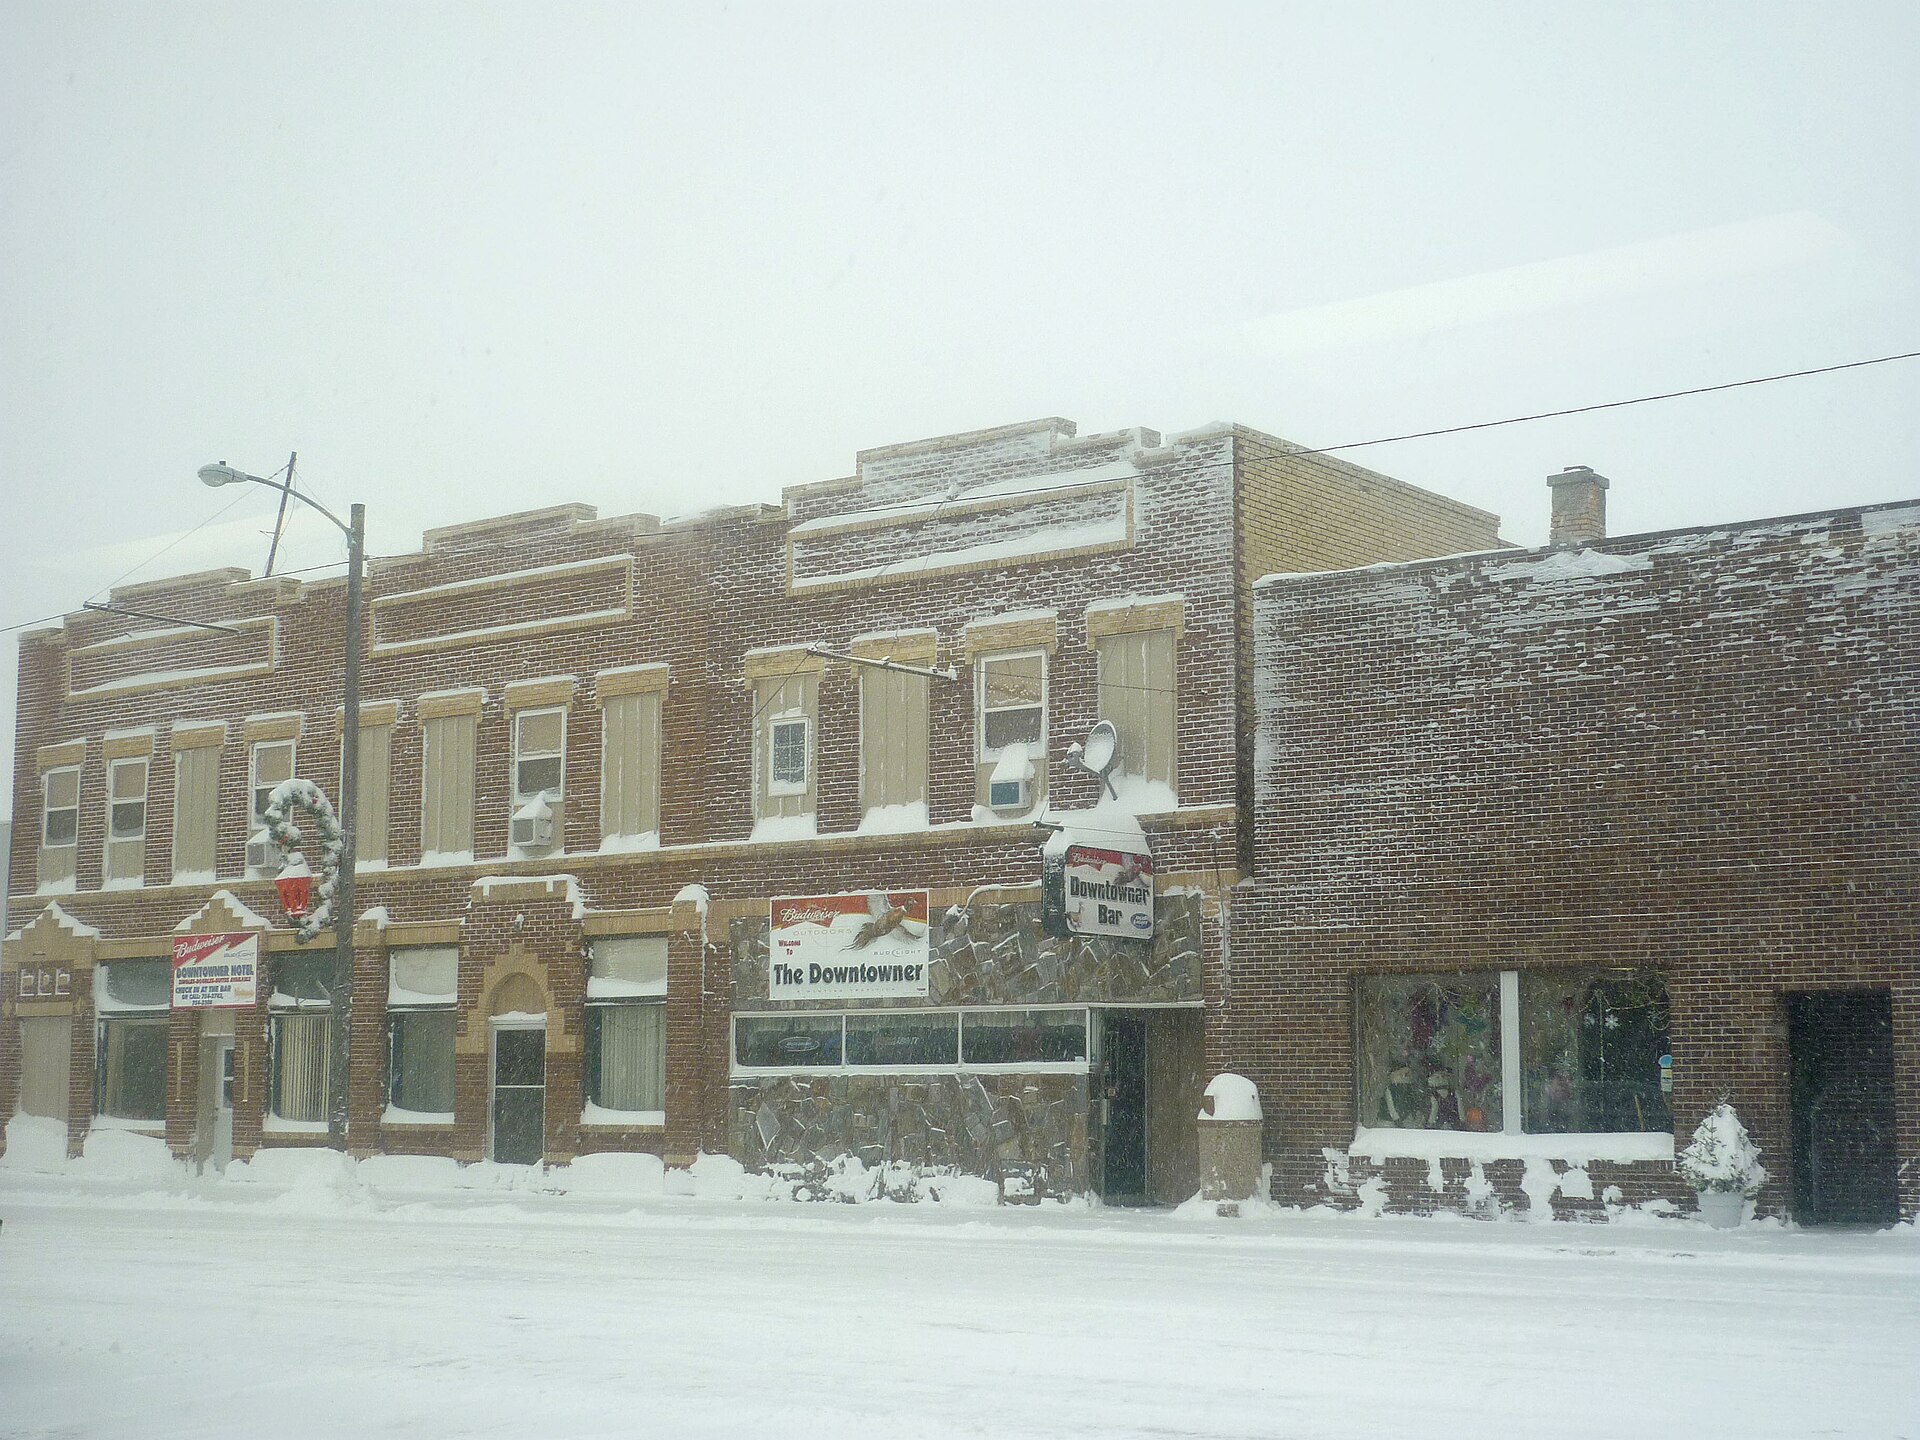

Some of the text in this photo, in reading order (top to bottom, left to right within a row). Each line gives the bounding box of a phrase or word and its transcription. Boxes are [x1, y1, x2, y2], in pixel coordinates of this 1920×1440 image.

[1070, 876, 1150, 905] Downtowner
[780, 907, 841, 922] Budweiser
[1098, 904, 1122, 925] Bar
[792, 928, 852, 936] OUTDOORS
[173, 935, 225, 958] Budweiser
[176, 965, 254, 978] DOWNTOWNER HOTEL
[773, 962, 924, 985] The Downtowner
